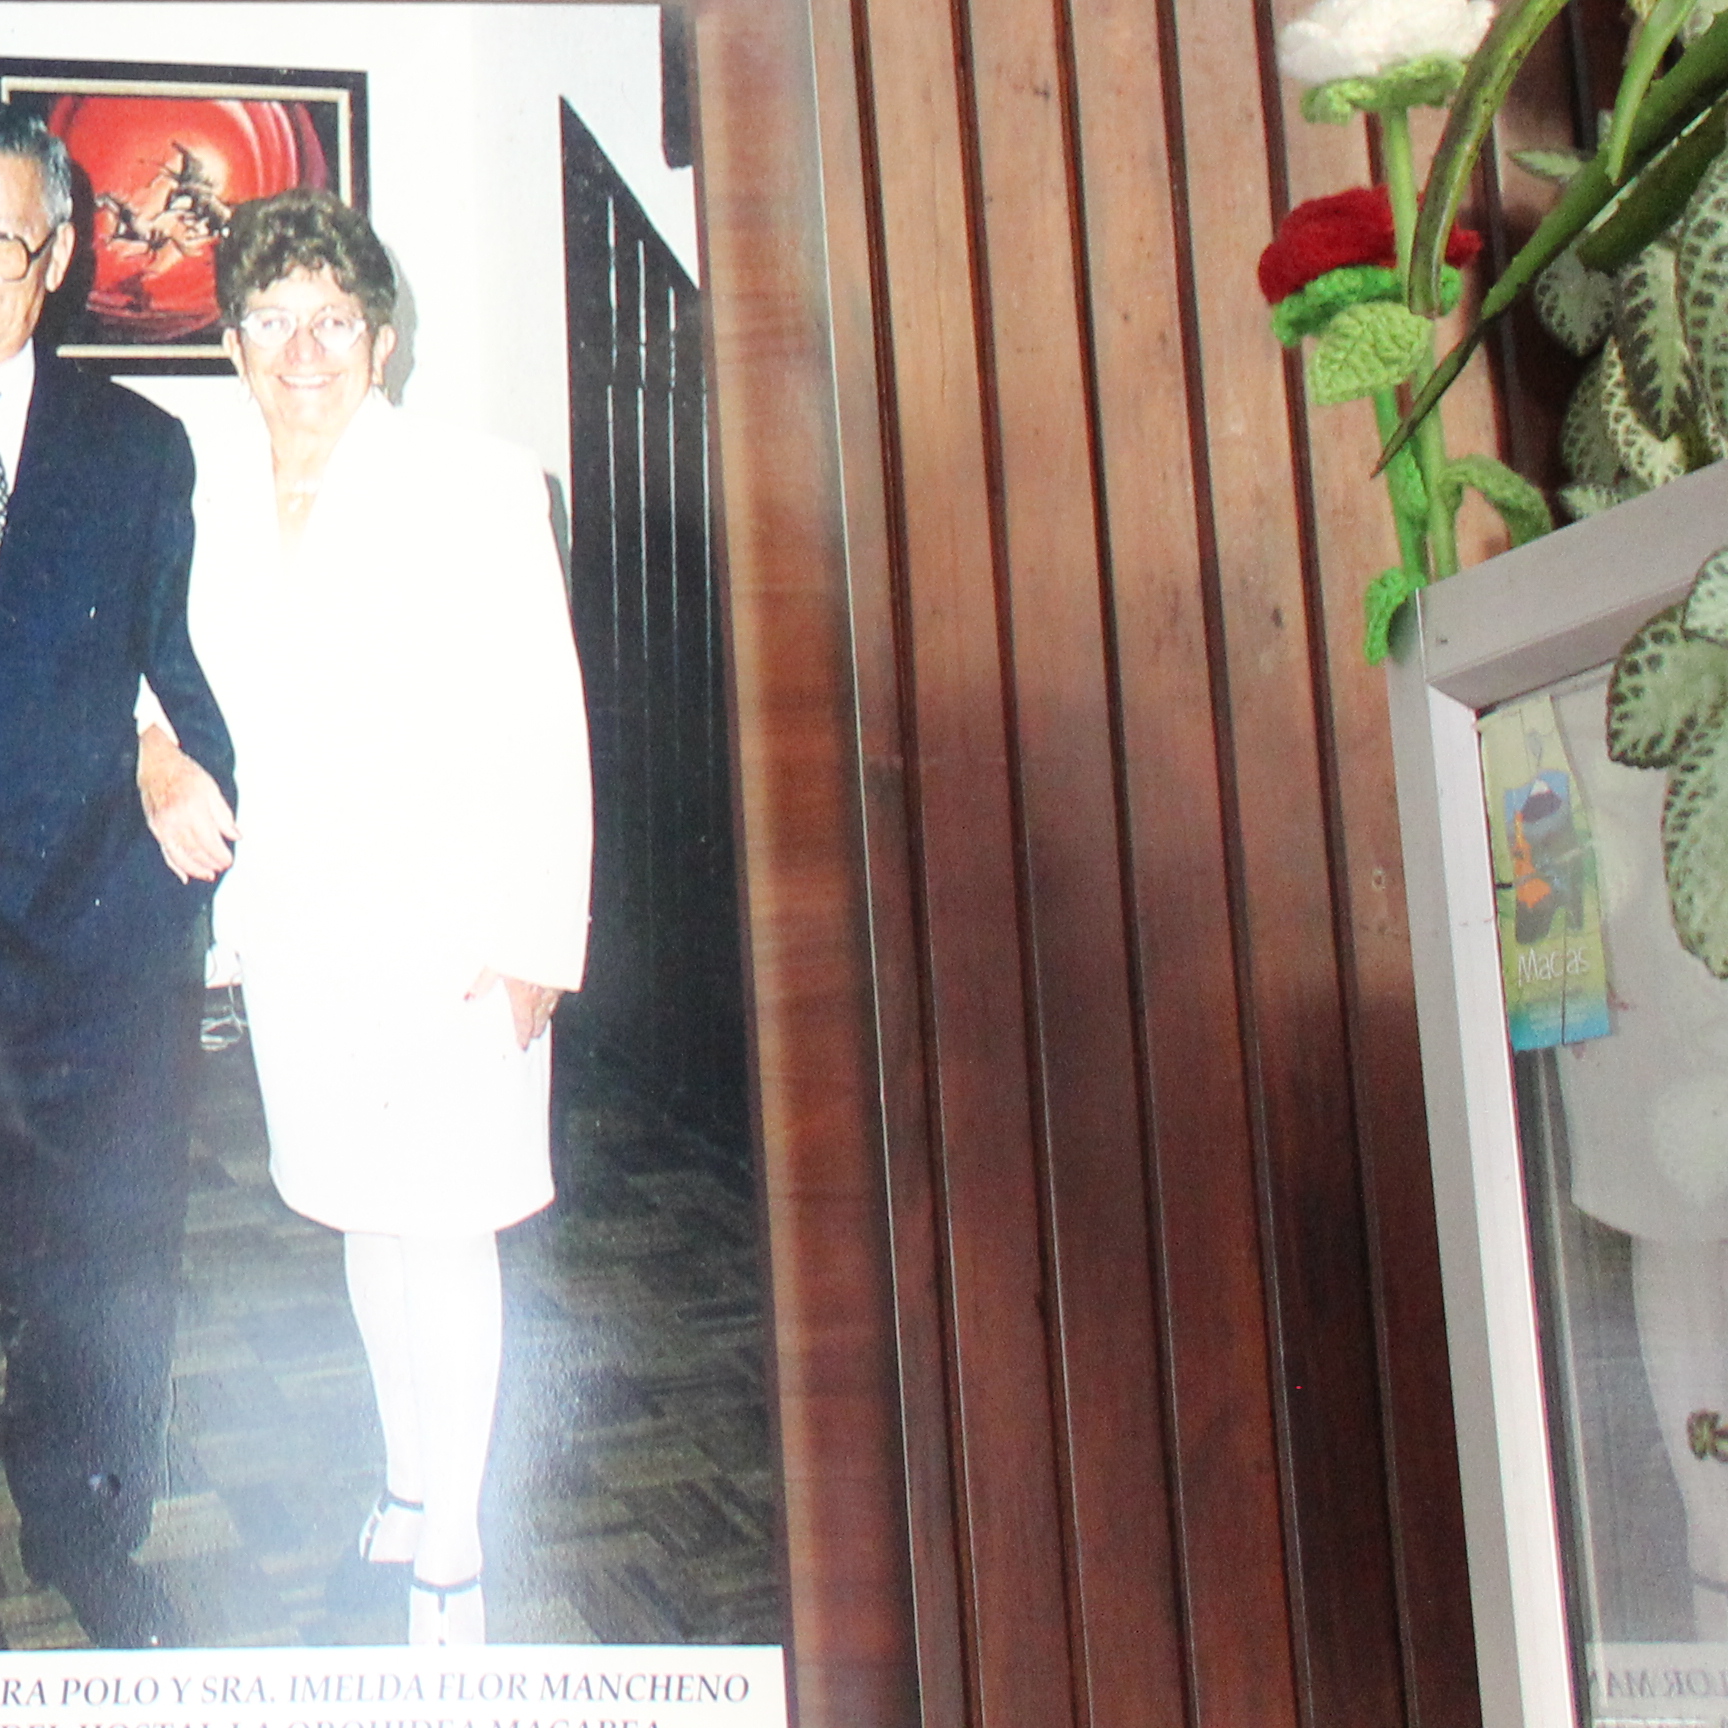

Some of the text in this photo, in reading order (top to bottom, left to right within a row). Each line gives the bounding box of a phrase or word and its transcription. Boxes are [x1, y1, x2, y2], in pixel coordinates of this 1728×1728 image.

[1518, 947, 1590, 988] Macas
[60, 1677, 160, 1706] POLO
[170, 1676, 194, 1704] Y
[200, 1675, 276, 1704] SRA.
[288, 1673, 425, 1703] IMELDA
[437, 1672, 529, 1702] FLOR
[539, 1672, 750, 1703] MANCHENO
